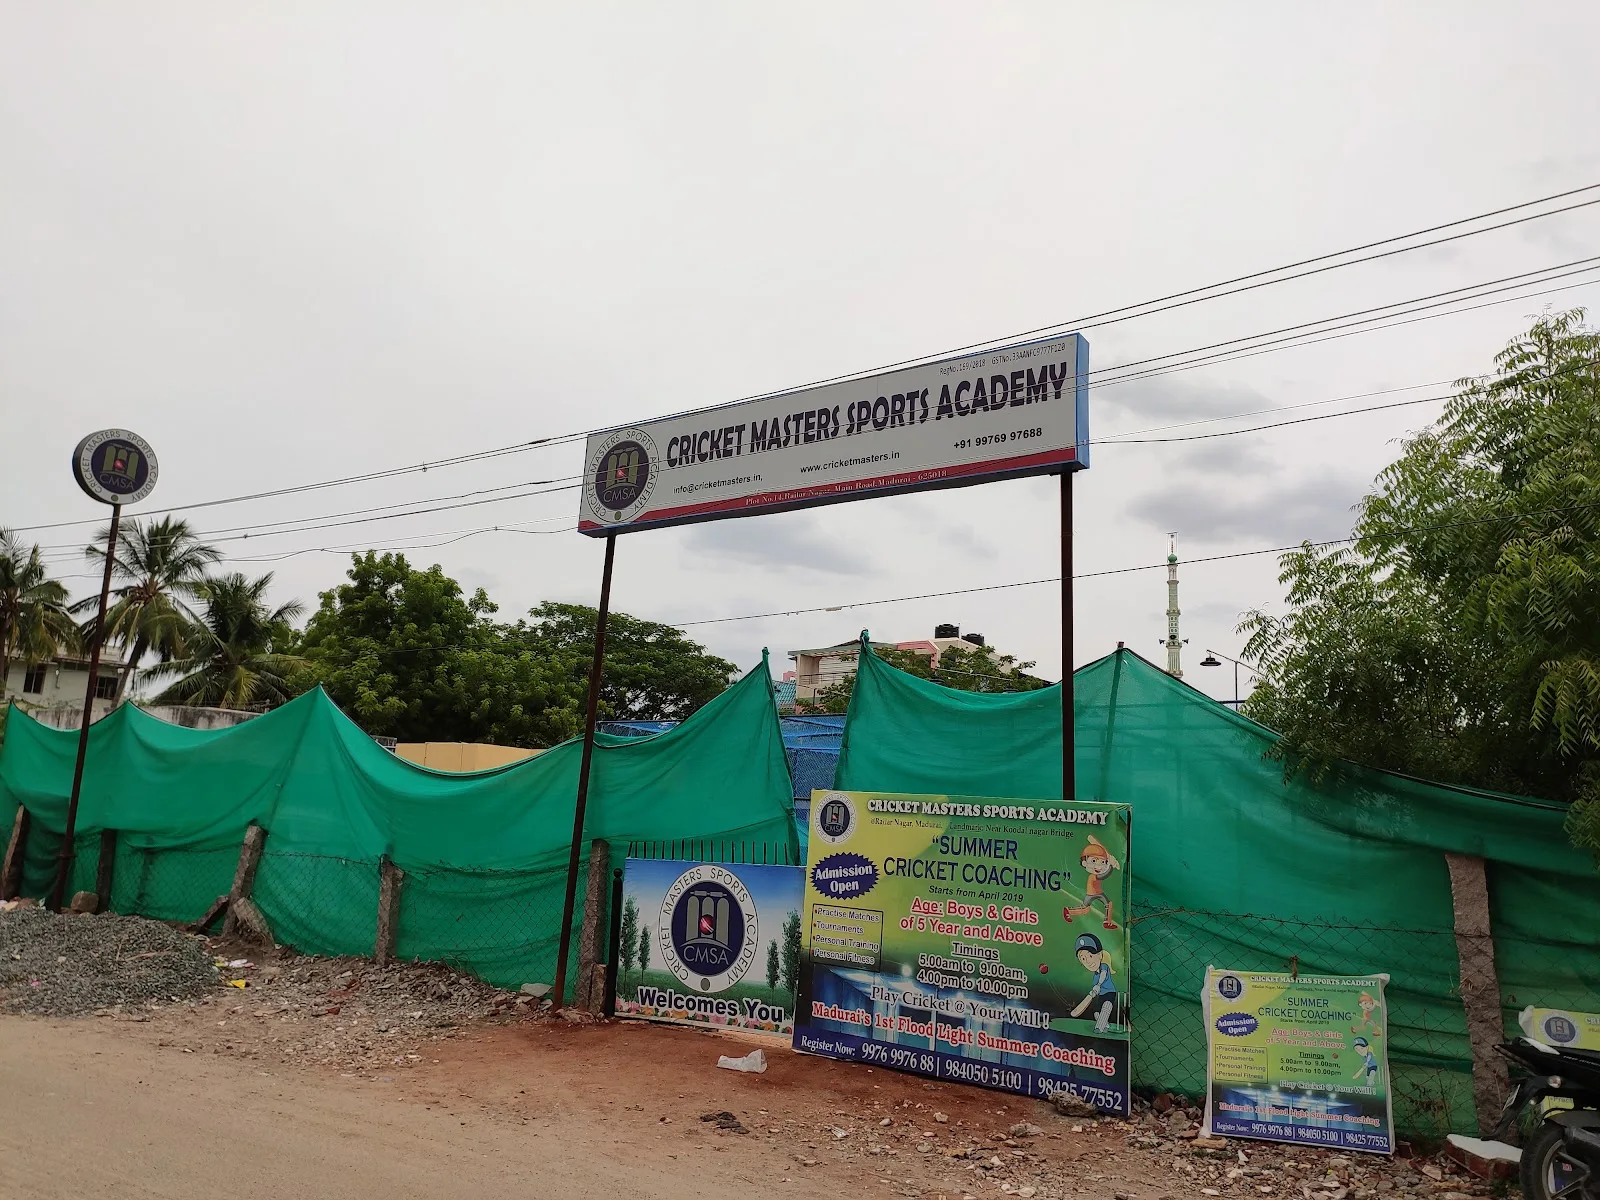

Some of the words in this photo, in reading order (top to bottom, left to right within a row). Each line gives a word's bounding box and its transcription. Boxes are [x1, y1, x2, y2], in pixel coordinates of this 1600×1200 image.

[666, 423, 746, 468] CRICKET
[750, 404, 841, 454] MASTERS
[846, 387, 929, 434] SPORTS
[936, 361, 1067, 421] ACADEMY
[85, 430, 121, 454] MASTERS
[126, 432, 154, 459] SPORTS
[626, 430, 653, 451] SPORTS
[954, 438, 972, 449] +91
[975, 433, 1006, 448] 99769
[1010, 427, 1042, 441] 97688
[590, 434, 621, 473] MASTERS
[800, 451, 900, 474] www.cricketmasters.in
[82, 457, 103, 494] CRICKET
[100, 474, 136, 490] CMSA
[131, 464, 157, 502] ACADEMY
[633, 456, 658, 512] ACADEMY
[588, 482, 607, 517] CRICKET
[603, 488, 636, 503] CMSA
[746, 498, 760, 506] Plot
[918, 470, 947, 480] 625018
[867, 799, 920, 814] CRICKET
[922, 802, 981, 817] MASTERS
[982, 805, 1035, 820] SPORTS
[1036, 808, 1108, 826] ACADEMY
[986, 824, 1001, 833] Near
[1030, 829, 1048, 838] nagar
[1050, 830, 1074, 839] Bridge
[815, 864, 873, 881] Admission
[883, 857, 959, 882] CRICKET
[663, 868, 702, 916] MASTERS
[710, 867, 748, 904] SPORTS
[830, 880, 860, 894] Open
[928, 885, 954, 895] Starts
[956, 888, 976, 898] from
[978, 890, 1000, 900] April
[1002, 892, 1024, 902] 2019
[818, 908, 848, 919] Practise
[848, 910, 880, 922] Matches
[912, 897, 943, 915] Age:
[947, 900, 983, 918] Boys
[987, 905, 998, 920] &
[1002, 906, 1038, 924] Girls
[816, 920, 864, 934] Tournaments
[900, 916, 915, 930] of
[918, 918, 925, 931] 5
[928, 919, 960, 935] Year
[964, 925, 990, 940] and
[994, 926, 1042, 945] Above
[660, 926, 689, 982] CRICKET
[728, 913, 757, 985] ACADEMY
[816, 934, 847, 947] Personal
[848, 938, 879, 952] Training
[952, 942, 999, 959] Timings
[683, 945, 729, 966] CMSA
[814, 949, 848, 962] Personal
[848, 951, 876, 964] Fitness
[918, 954, 960, 970] 5.00am
[962, 961, 974, 973] to
[980, 962, 1028, 982] 9.00am,
[917, 970, 960, 989] 4.00pm
[961, 978, 974, 990] to
[976, 978, 1028, 998] 10.00pm
[1313, 978, 1340, 986] SPORTS
[638, 988, 738, 1016] Welcomes
[746, 1000, 783, 1023] You
[870, 986, 900, 1006] Play
[902, 991, 951, 1012] Cricket
[954, 1000, 966, 1013] @
[970, 1002, 1004, 1022] Your
[1007, 1008, 1042, 1026] Will
[1258, 1007, 1298, 1018] CRICKET
[1218, 1018, 1256, 1028] Admission
[1228, 1026, 1248, 1034] Open
[1292, 1028, 1313, 1038] Boys
[1324, 1030, 1343, 1039] Girls
[876, 1014, 894, 1029] 1st
[898, 1018, 934, 1037] Flood
[937, 1023, 973, 1046] Light
[978, 1032, 1038, 1056] Summer
[1041, 1042, 1115, 1074] Coaching
[1319, 1040, 1346, 1049] Above
[1280, 1058, 1303, 1066] 5.00am
[1298, 1052, 1325, 1060] Timings
[801, 1036, 834, 1052] Register
[834, 1042, 856, 1056] Now:
[862, 1042, 888, 1062] 9976
[890, 1049, 918, 1069] 9976
[920, 1054, 934, 1072] 88
[946, 1060, 988, 1083] 984050
[992, 1070, 1022, 1090] 5100
[1081, 1084, 1122, 1111] 77552
[1310, 1111, 1343, 1121] Summer
[1343, 1114, 1380, 1127] Coaching
[1252, 1123, 1267, 1134] 9976
[1268, 1124, 1284, 1136] 9976
[1298, 1128, 1322, 1140] 984050
[1322, 1130, 1338, 1142] 5100
[1346, 1132, 1366, 1144] 98425
[1368, 1135, 1388, 1148] 77552
